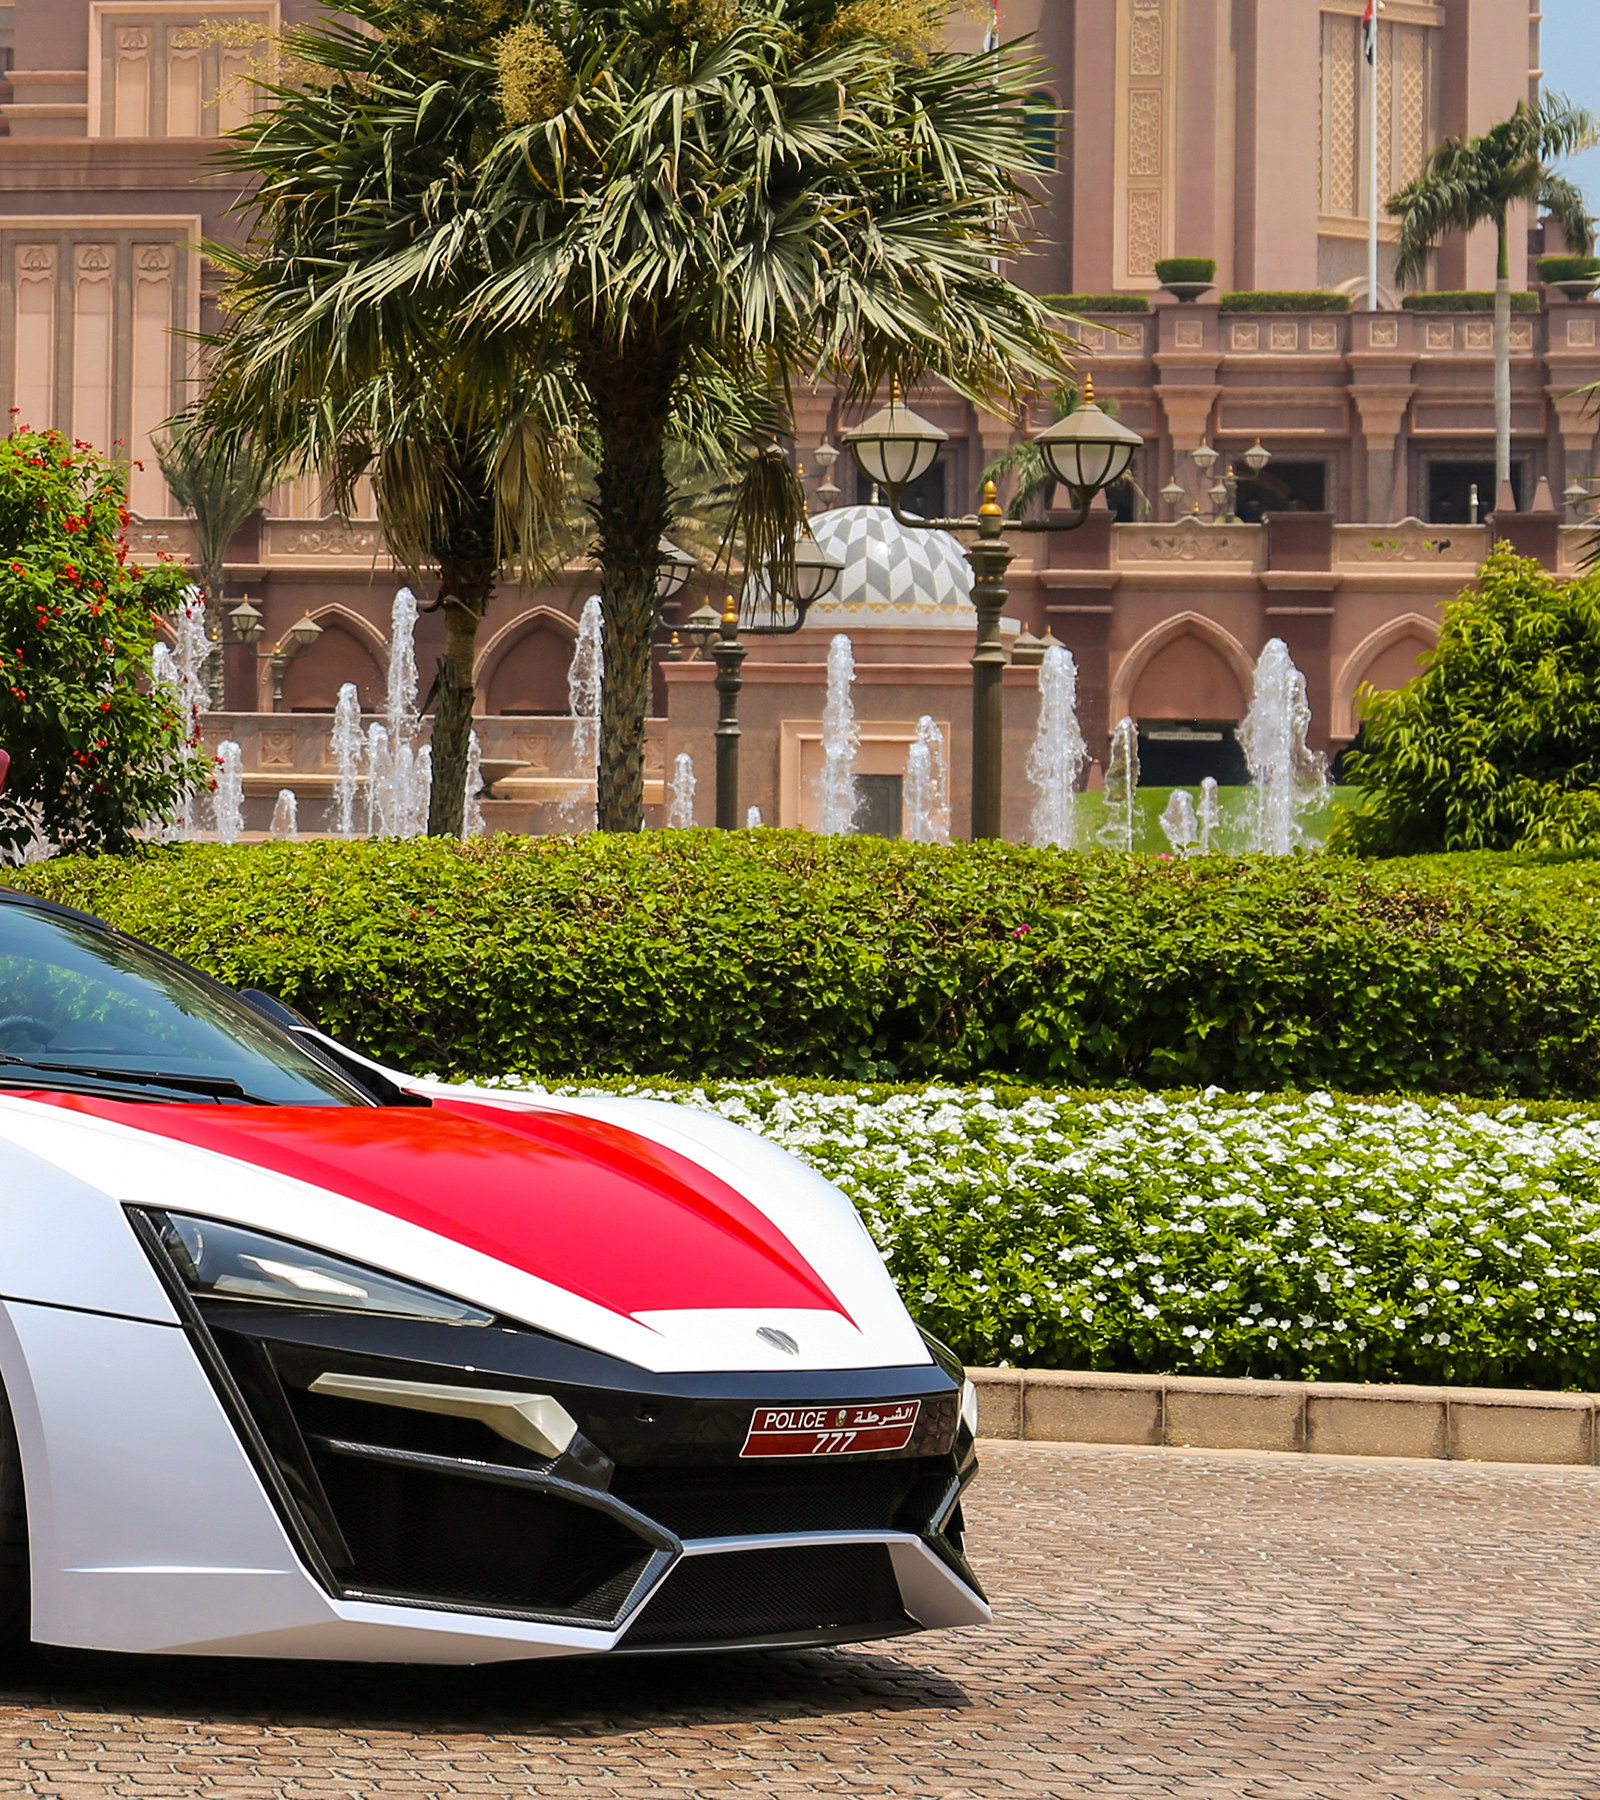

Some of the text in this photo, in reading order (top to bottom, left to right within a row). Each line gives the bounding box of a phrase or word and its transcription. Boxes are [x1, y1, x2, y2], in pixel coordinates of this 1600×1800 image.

[764, 1411, 827, 1430] POLICE
[853, 1406, 913, 1426] الشرطة
[811, 1431, 857, 1454] 777
